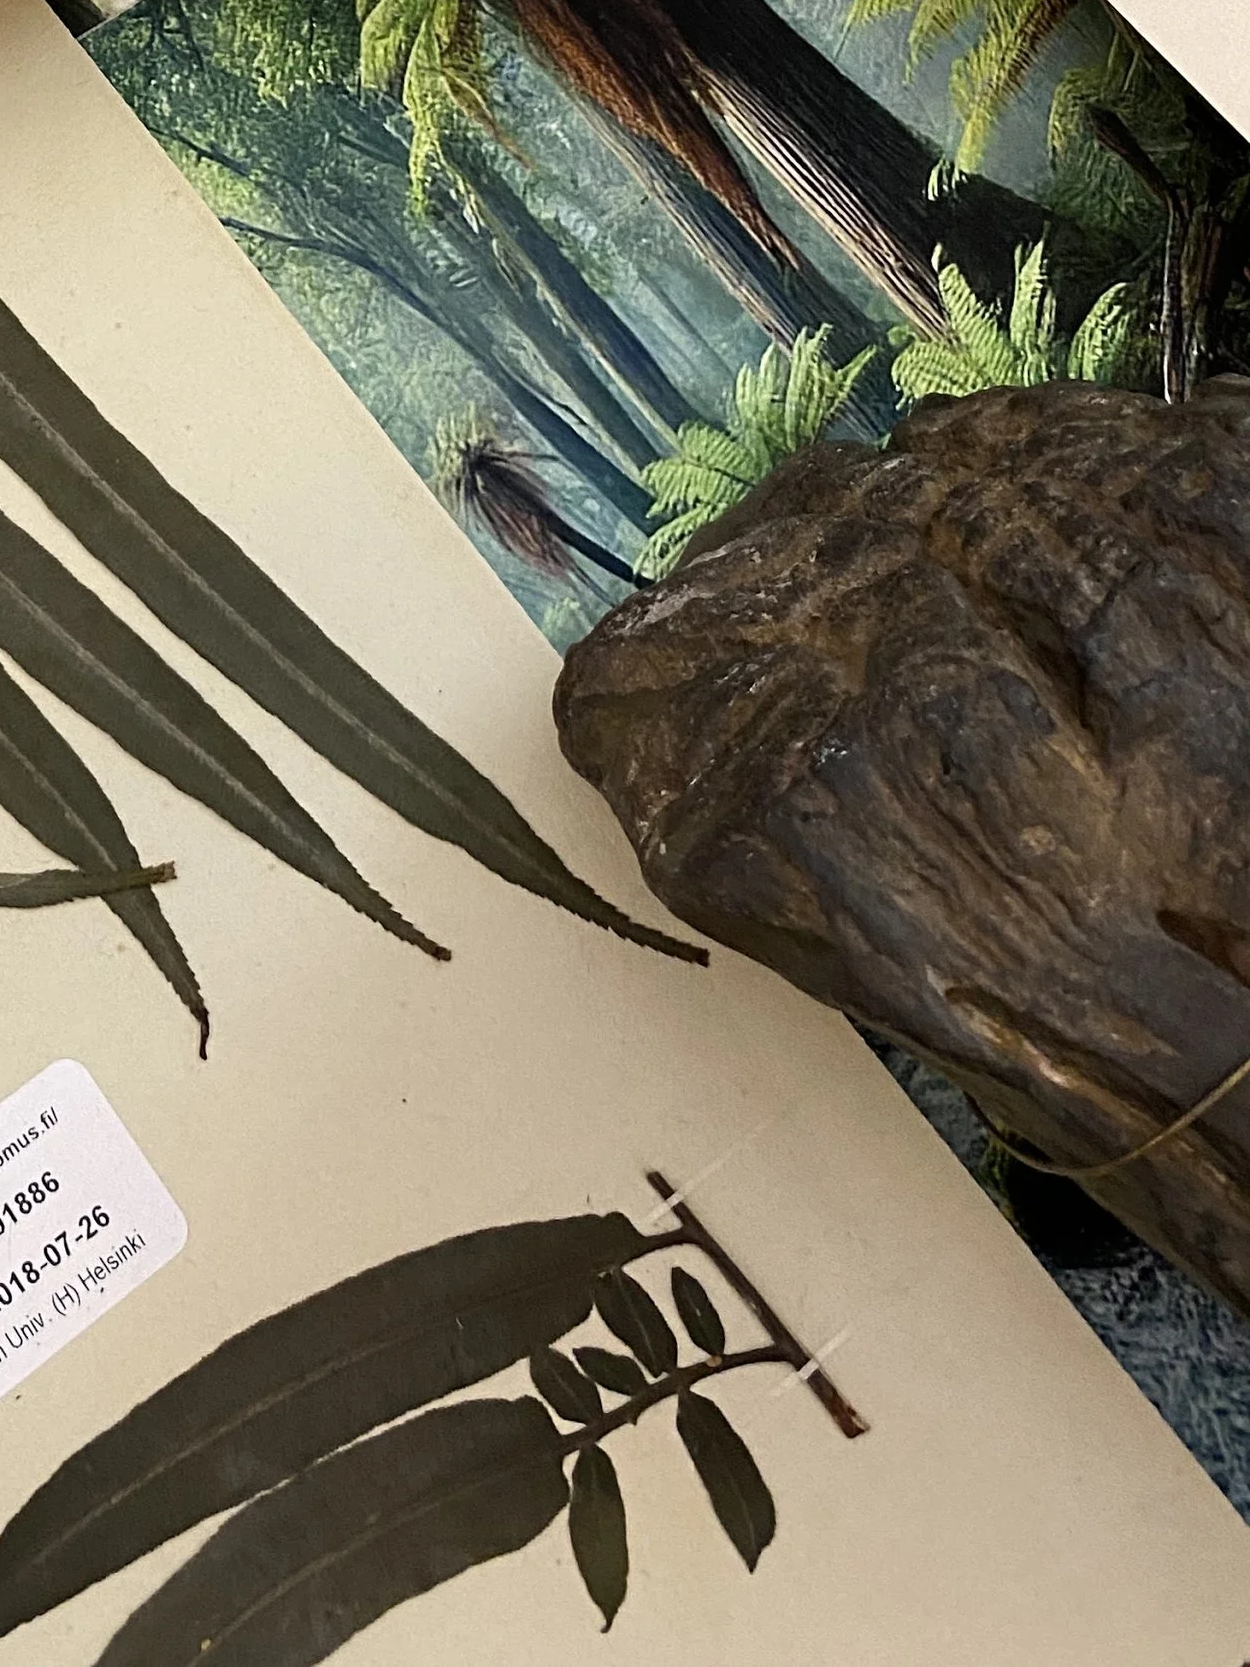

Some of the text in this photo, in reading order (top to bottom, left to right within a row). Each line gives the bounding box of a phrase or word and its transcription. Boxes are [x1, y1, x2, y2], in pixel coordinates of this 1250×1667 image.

[7, 1314, 54, 1351] Univ.
[51, 1285, 82, 1317] (H)
[79, 1231, 146, 1293] Helsinki
